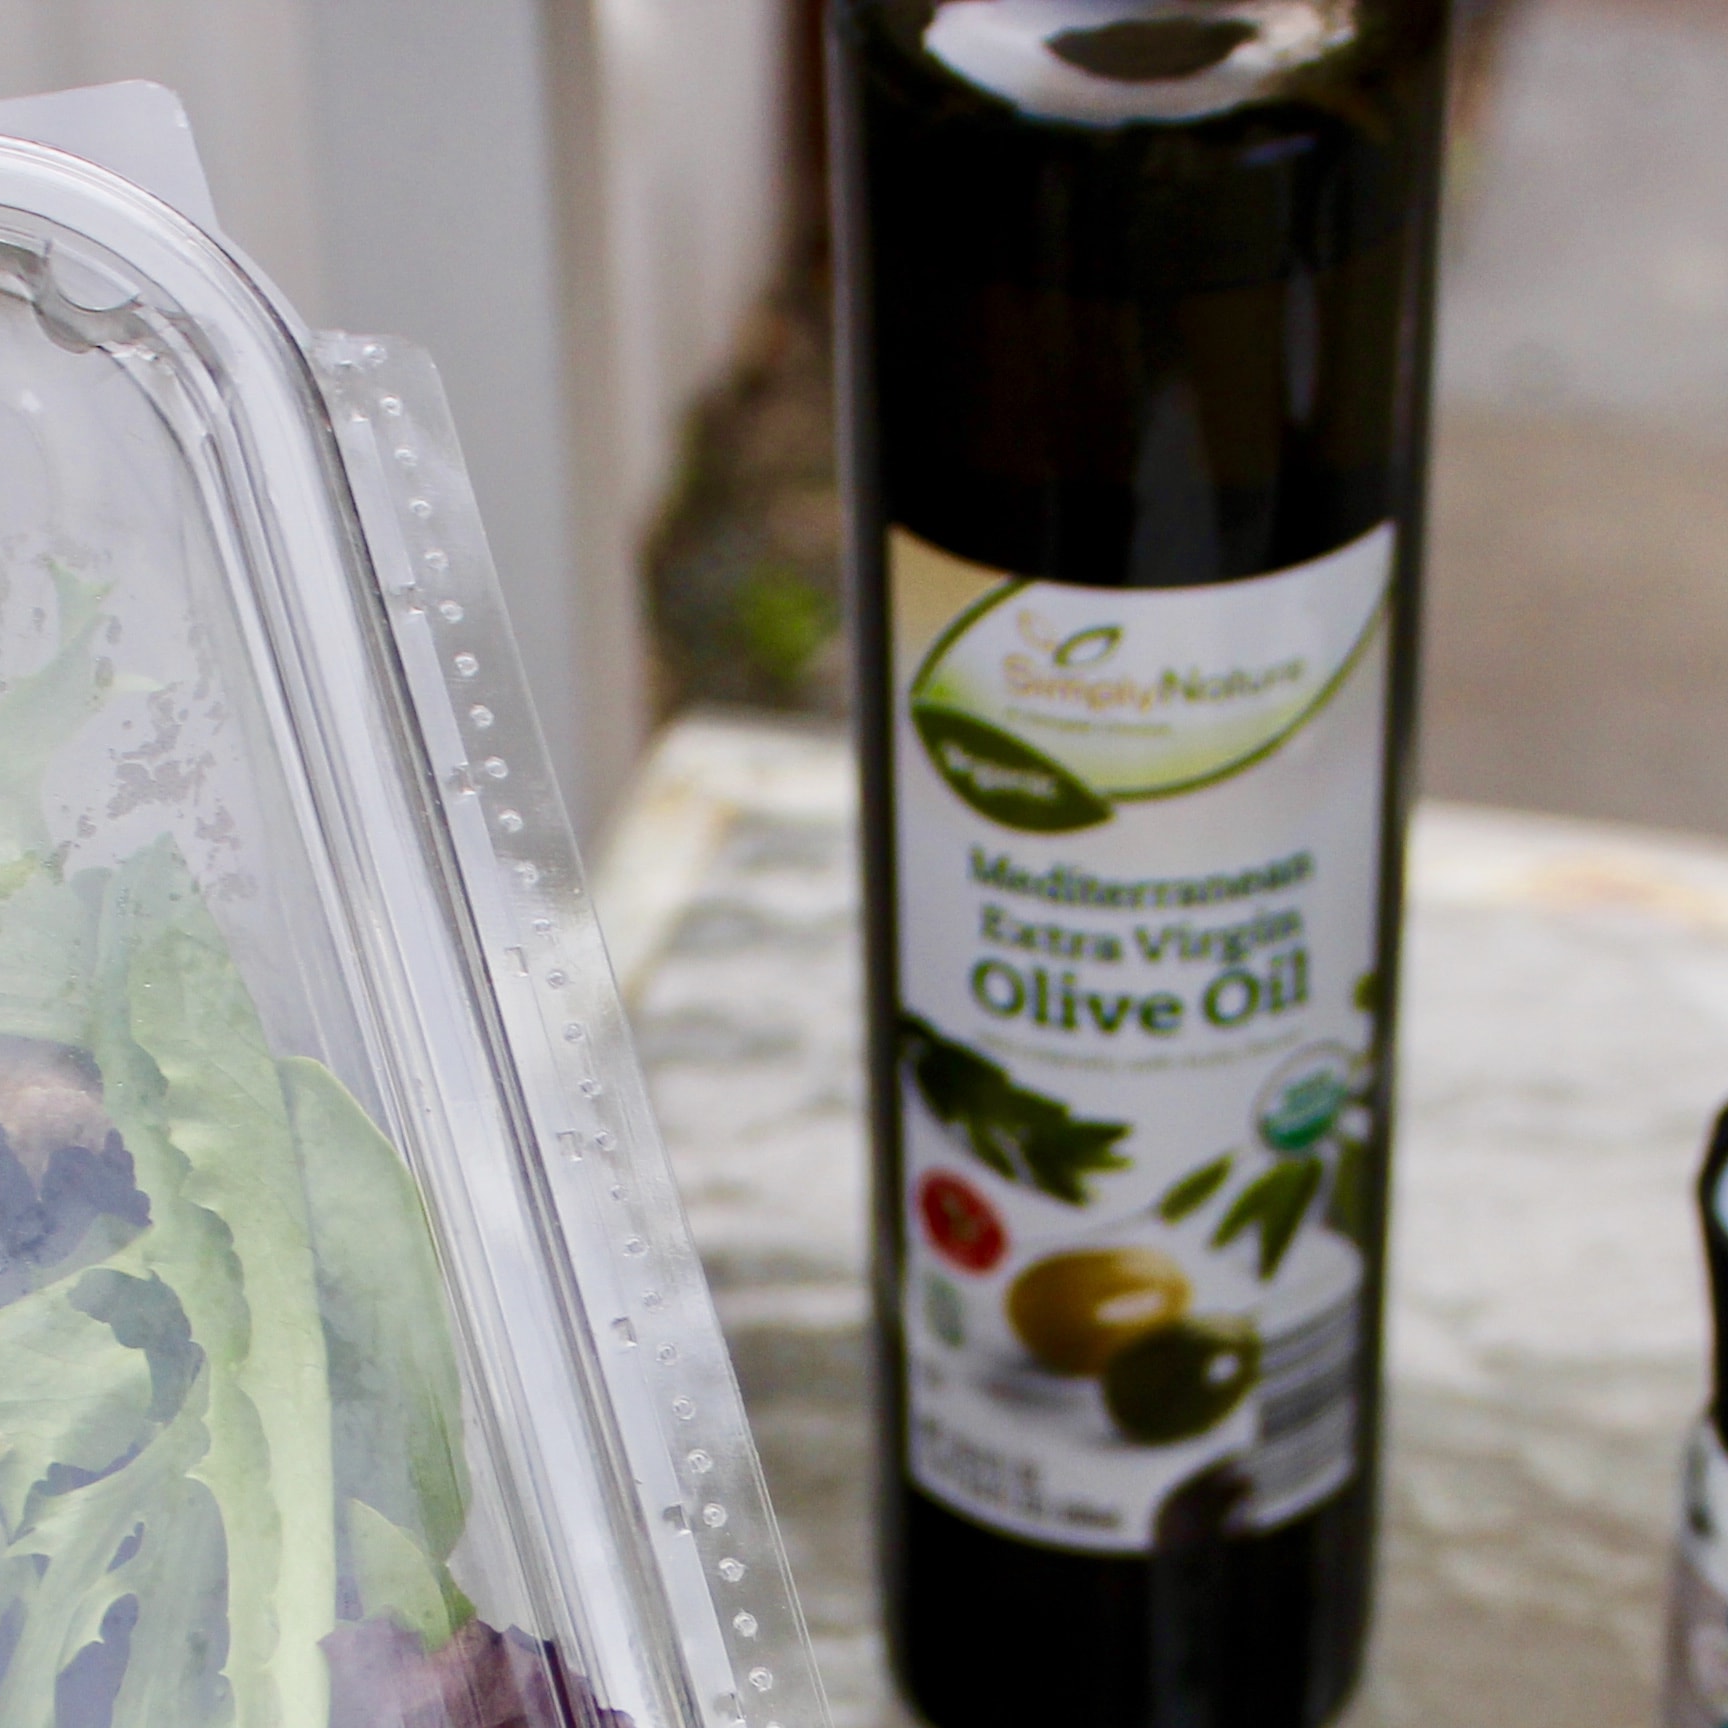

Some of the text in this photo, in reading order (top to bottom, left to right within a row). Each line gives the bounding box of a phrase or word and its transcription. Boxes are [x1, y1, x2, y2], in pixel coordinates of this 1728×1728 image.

[968, 843, 1315, 910] Mediterranean
[981, 903, 1303, 965] Extra Virgin
[969, 948, 1307, 1036] Olive Oil
